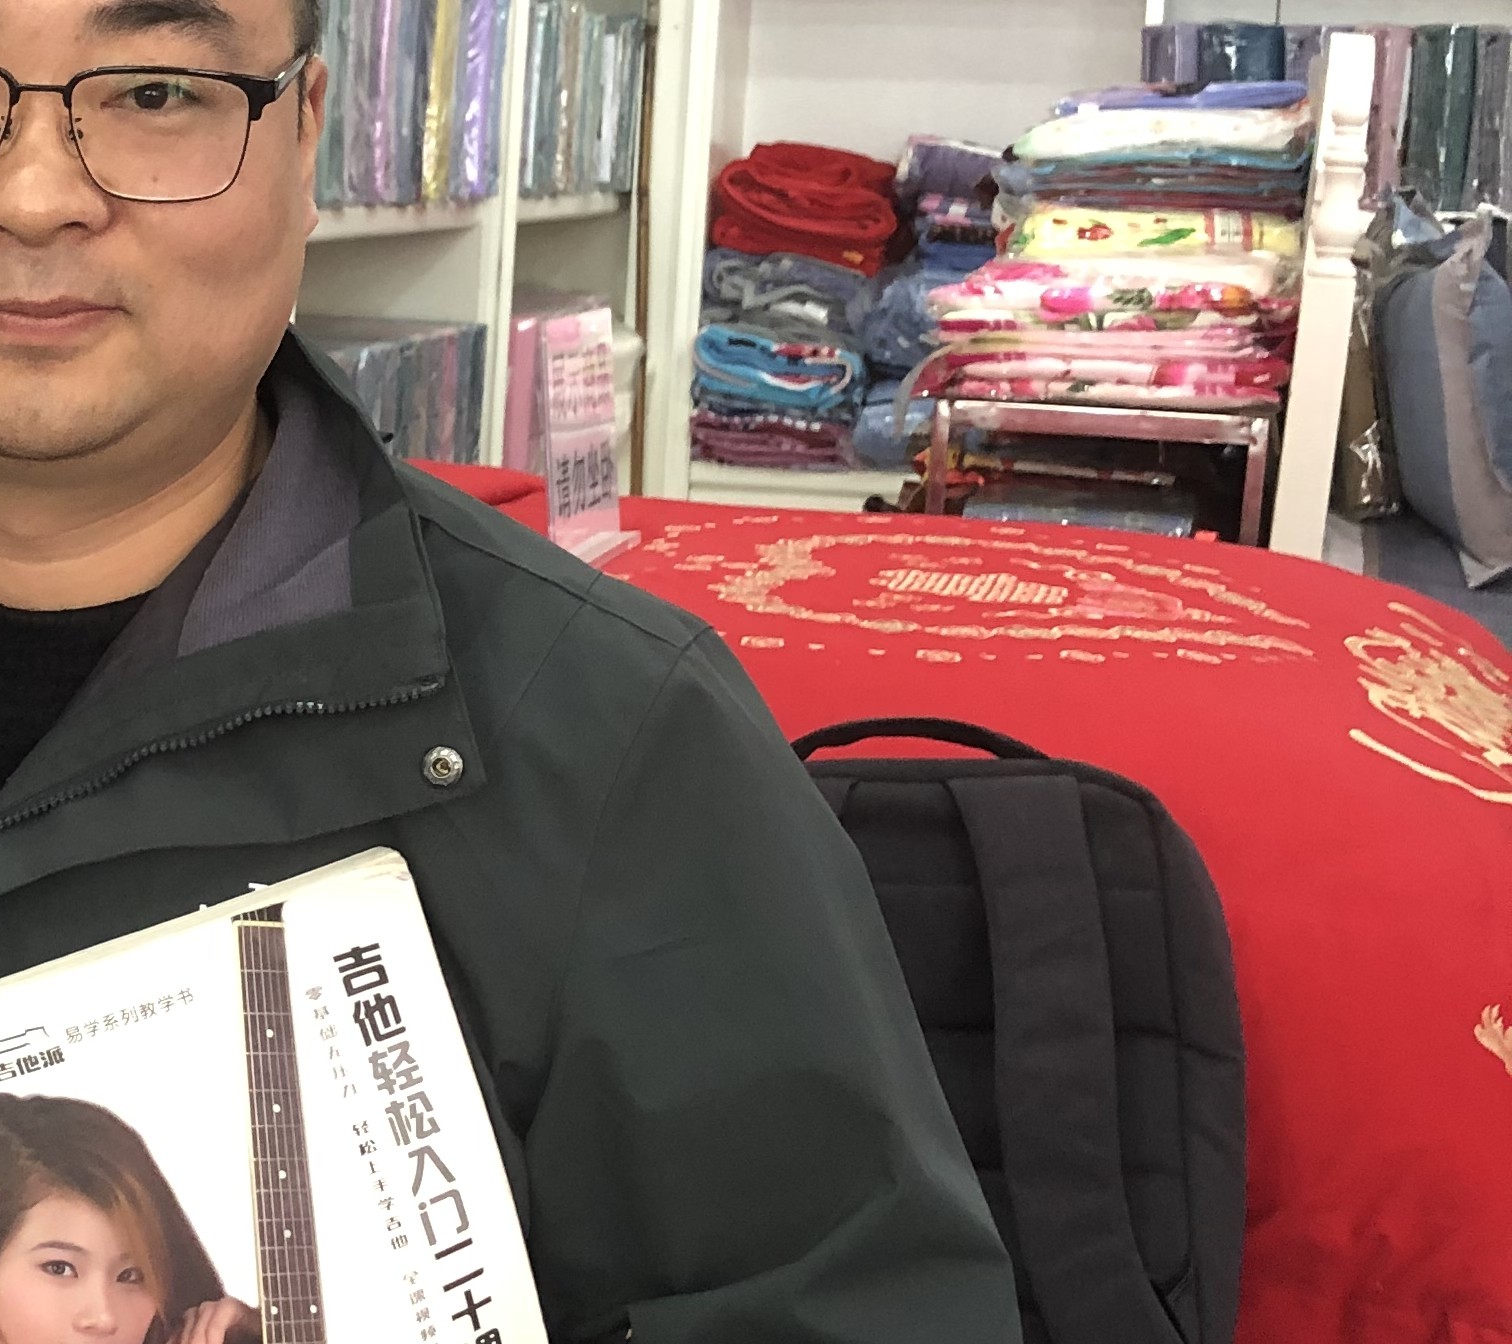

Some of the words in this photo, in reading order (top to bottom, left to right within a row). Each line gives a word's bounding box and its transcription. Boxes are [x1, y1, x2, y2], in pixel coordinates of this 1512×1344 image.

[65, 987, 195, 1045] 易学系列教学书
[306, 986, 357, 1099] 零基础无压力
[352, 1120, 409, 1250] 轻松上手学吉他
